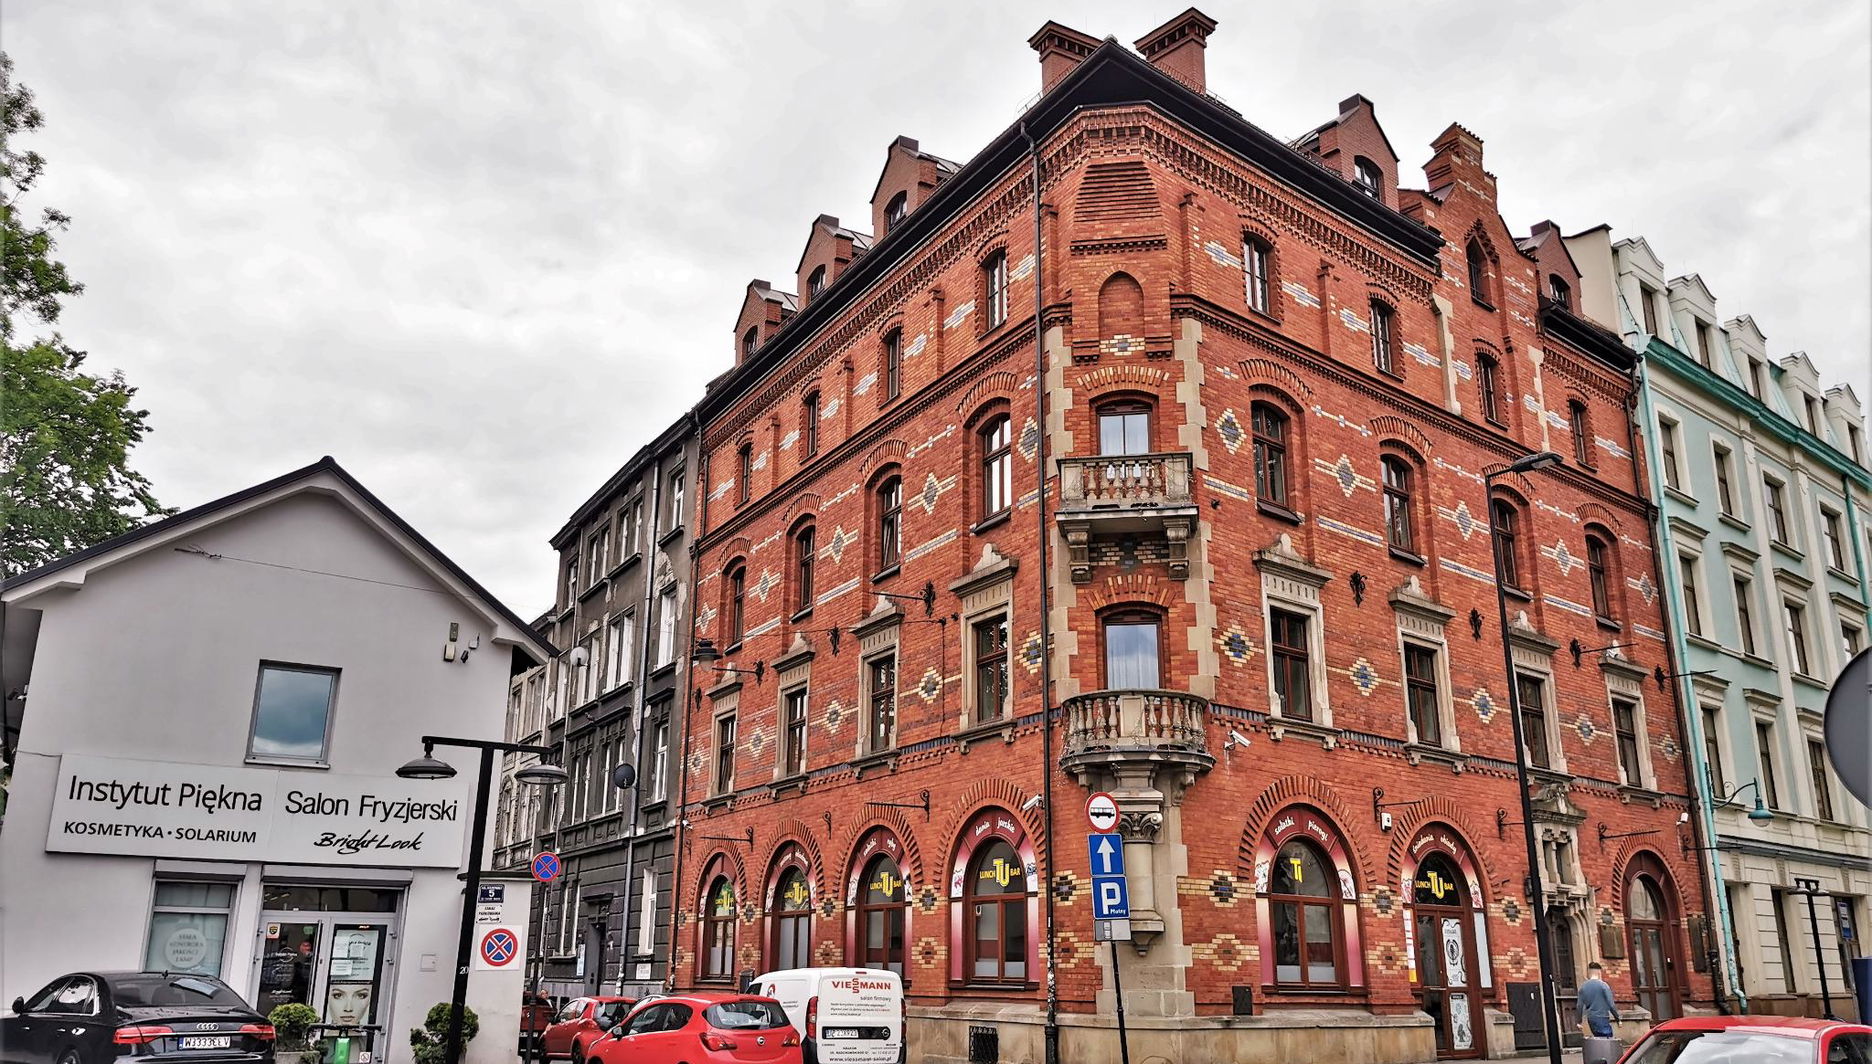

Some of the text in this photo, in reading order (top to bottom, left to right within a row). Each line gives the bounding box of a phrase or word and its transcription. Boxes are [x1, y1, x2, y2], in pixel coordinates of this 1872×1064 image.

[69, 775, 262, 814] Instytut Piękna
[285, 790, 458, 823] Salon Fryzjerski
[64, 821, 257, 843] KOSMETYKA SOLARIUM
[314, 829, 424, 854] Bright Look
[1308, 820, 1328, 841] pierogi
[880, 871, 893, 897] TU
[980, 858, 1020, 887] LUNCH TU BAR
[1415, 871, 1454, 899] LUNCH TU BAR
[489, 889, 495, 897] 5
[1100, 882, 1121, 915] P
[832, 978, 891, 993] VIESSMANN
